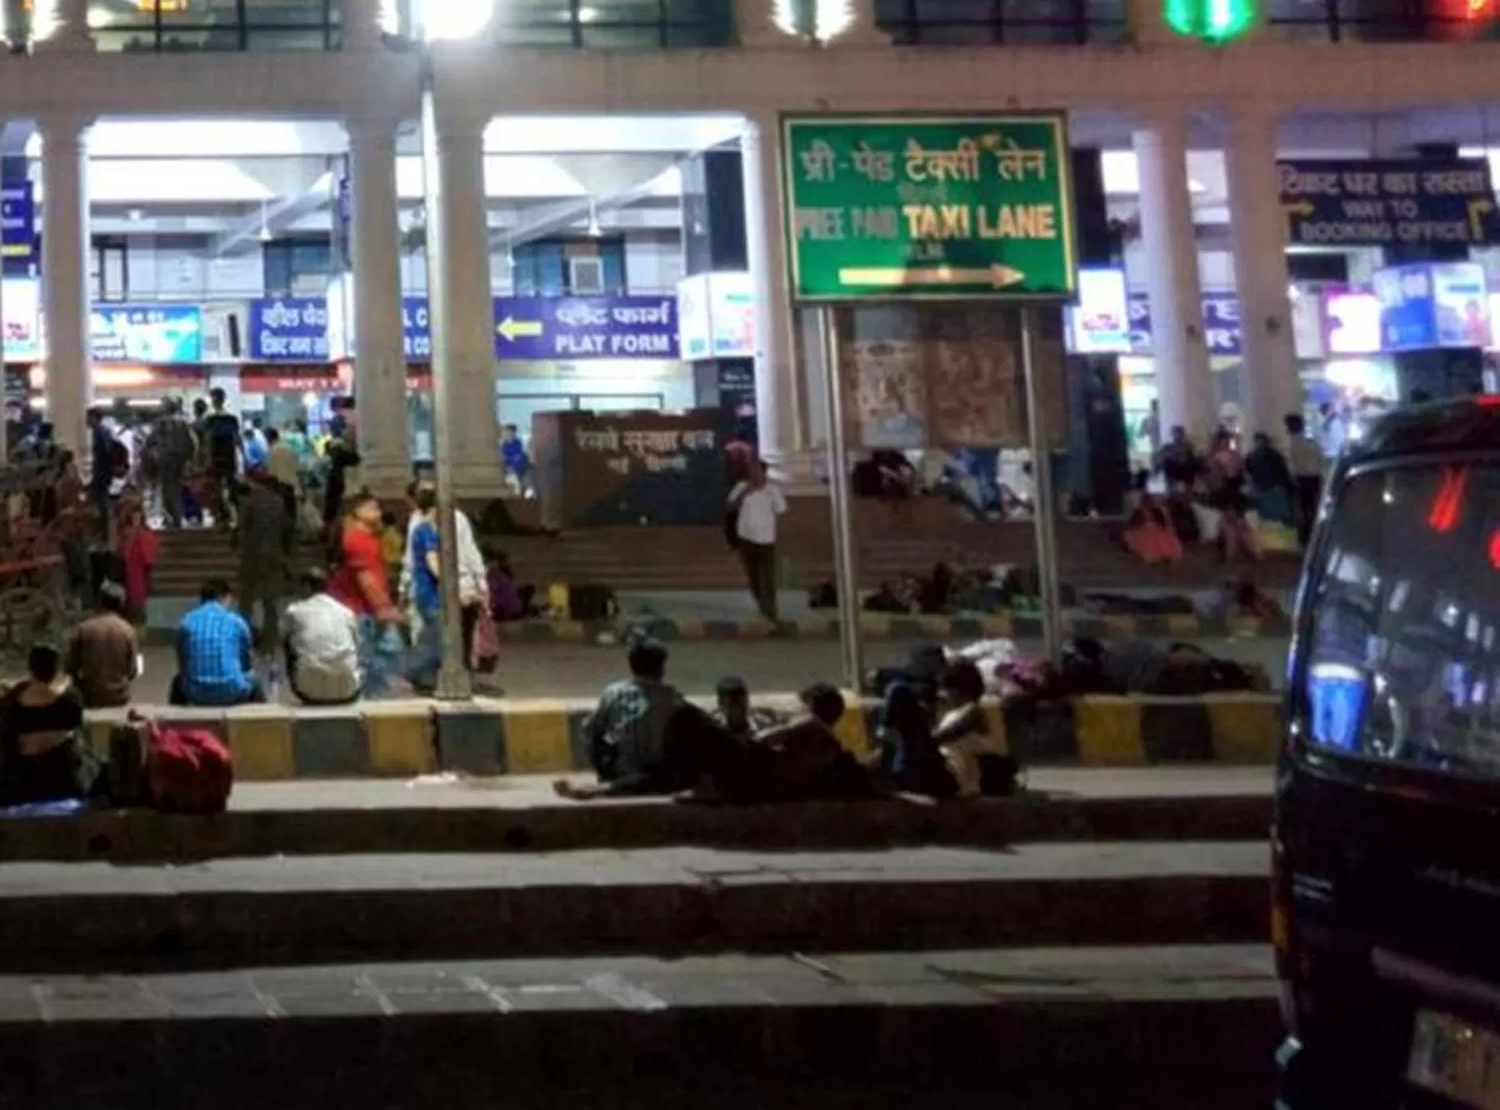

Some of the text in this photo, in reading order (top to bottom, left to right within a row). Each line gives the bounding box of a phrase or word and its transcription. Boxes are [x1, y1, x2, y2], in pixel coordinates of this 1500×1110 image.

[903, 138, 981, 182] टैक्सी
[997, 139, 1047, 182] लेन
[902, 204, 971, 239] TAXI
[978, 204, 1058, 238] LANE
[555, 334, 671, 353] PLAT FORM
